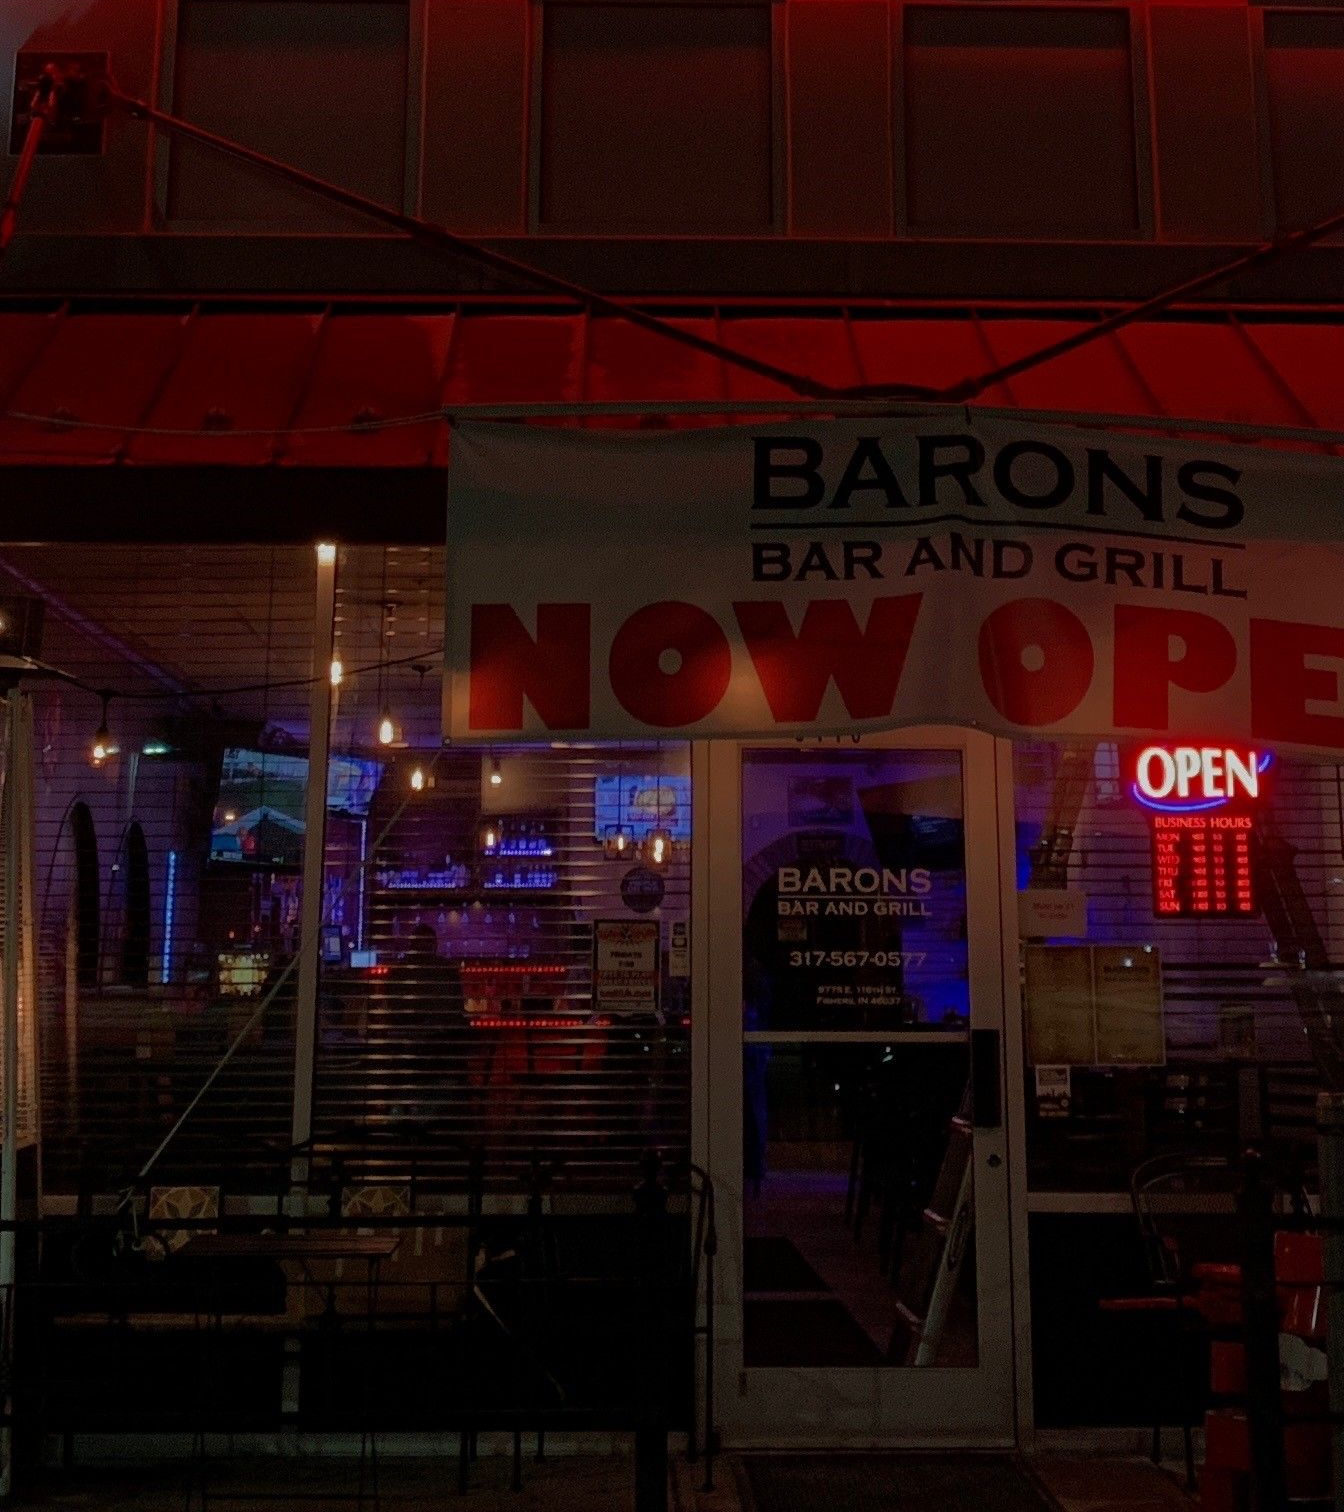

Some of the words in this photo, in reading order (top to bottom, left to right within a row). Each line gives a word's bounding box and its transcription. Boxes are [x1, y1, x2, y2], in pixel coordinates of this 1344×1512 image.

[751, 434, 1246, 530] BARONS
[752, 540, 883, 582] BAR
[907, 532, 1034, 580] AND
[1055, 542, 1248, 598] GRILL
[468, 593, 924, 730] NOW
[1136, 746, 1259, 799] OPEN
[1155, 817, 1207, 828] BUSINESS
[1210, 817, 1253, 829] HOURS
[777, 867, 933, 893] BARONS
[777, 901, 819, 916] BAR
[824, 901, 869, 916] AND
[873, 901, 933, 917] GRILL
